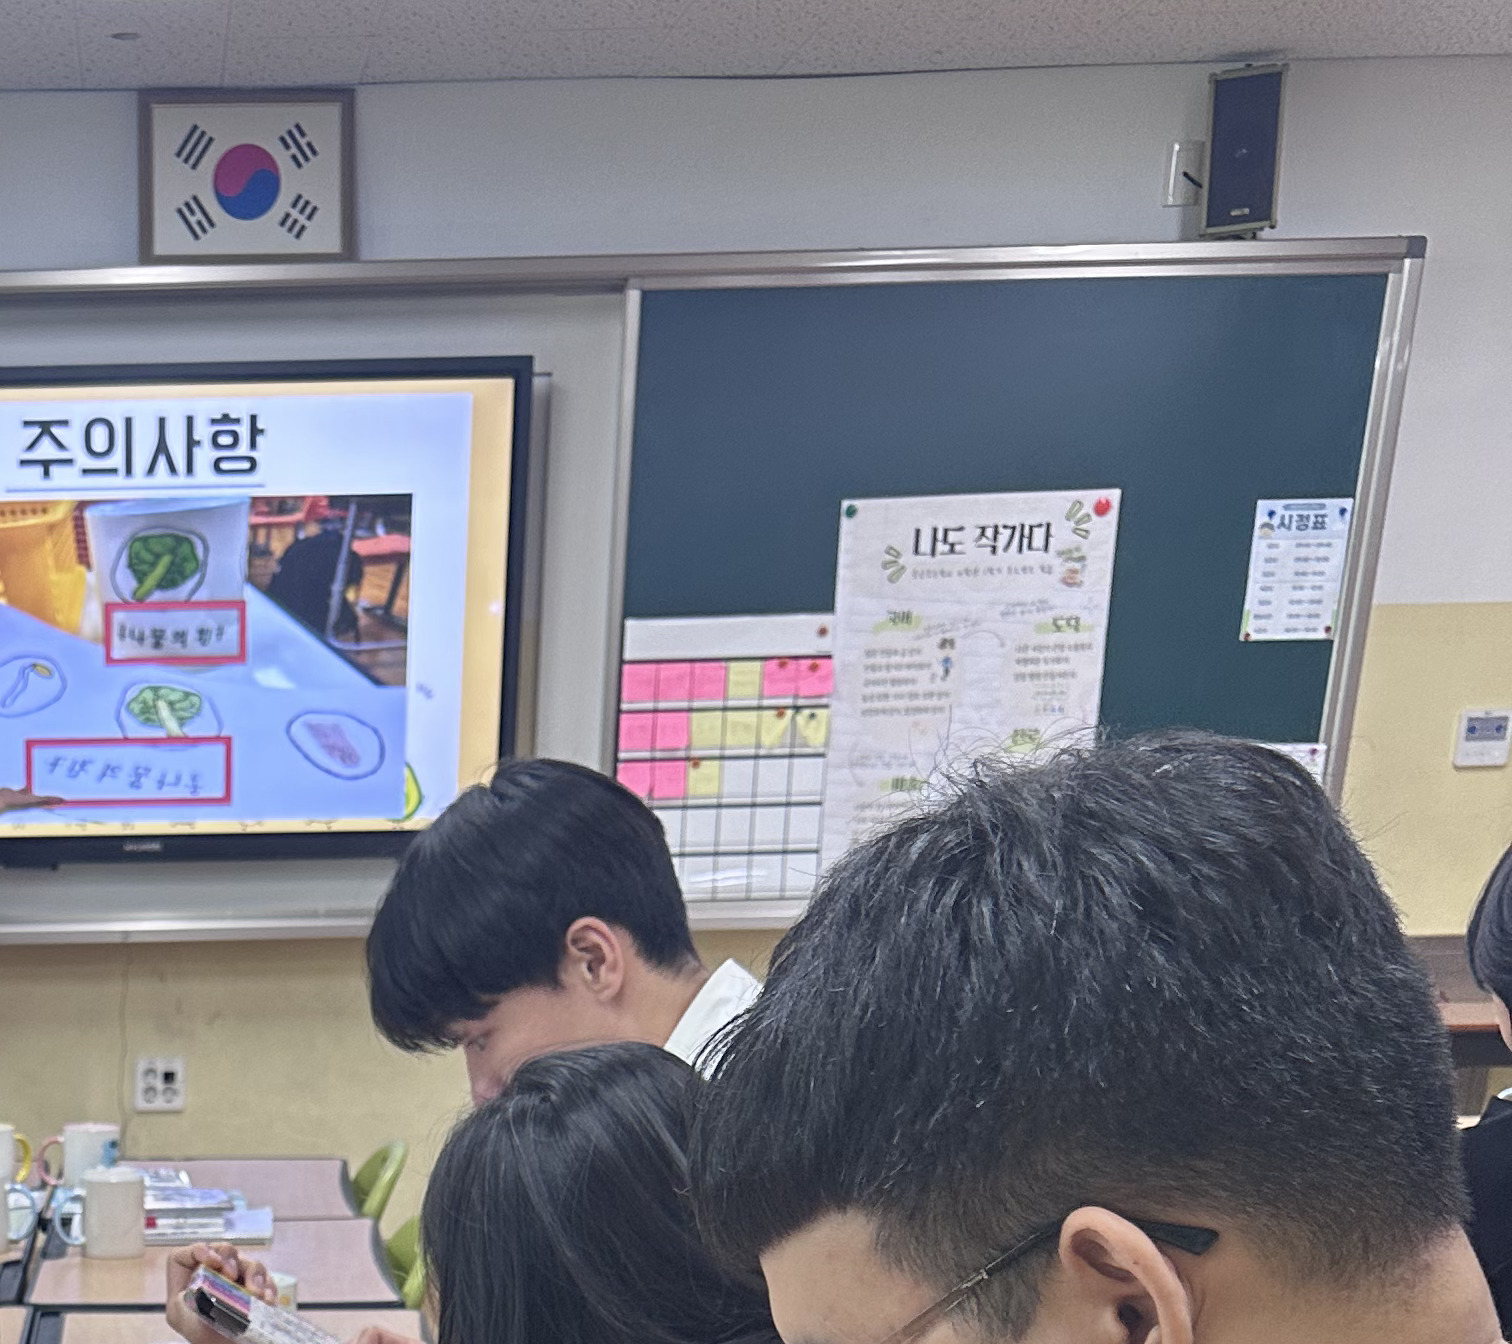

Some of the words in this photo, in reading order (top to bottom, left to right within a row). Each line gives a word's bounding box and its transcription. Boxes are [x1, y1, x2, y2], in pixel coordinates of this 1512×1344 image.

[19, 413, 265, 479] 주의사항
[912, 525, 968, 558] 나도
[975, 522, 1056, 556] 작가다
